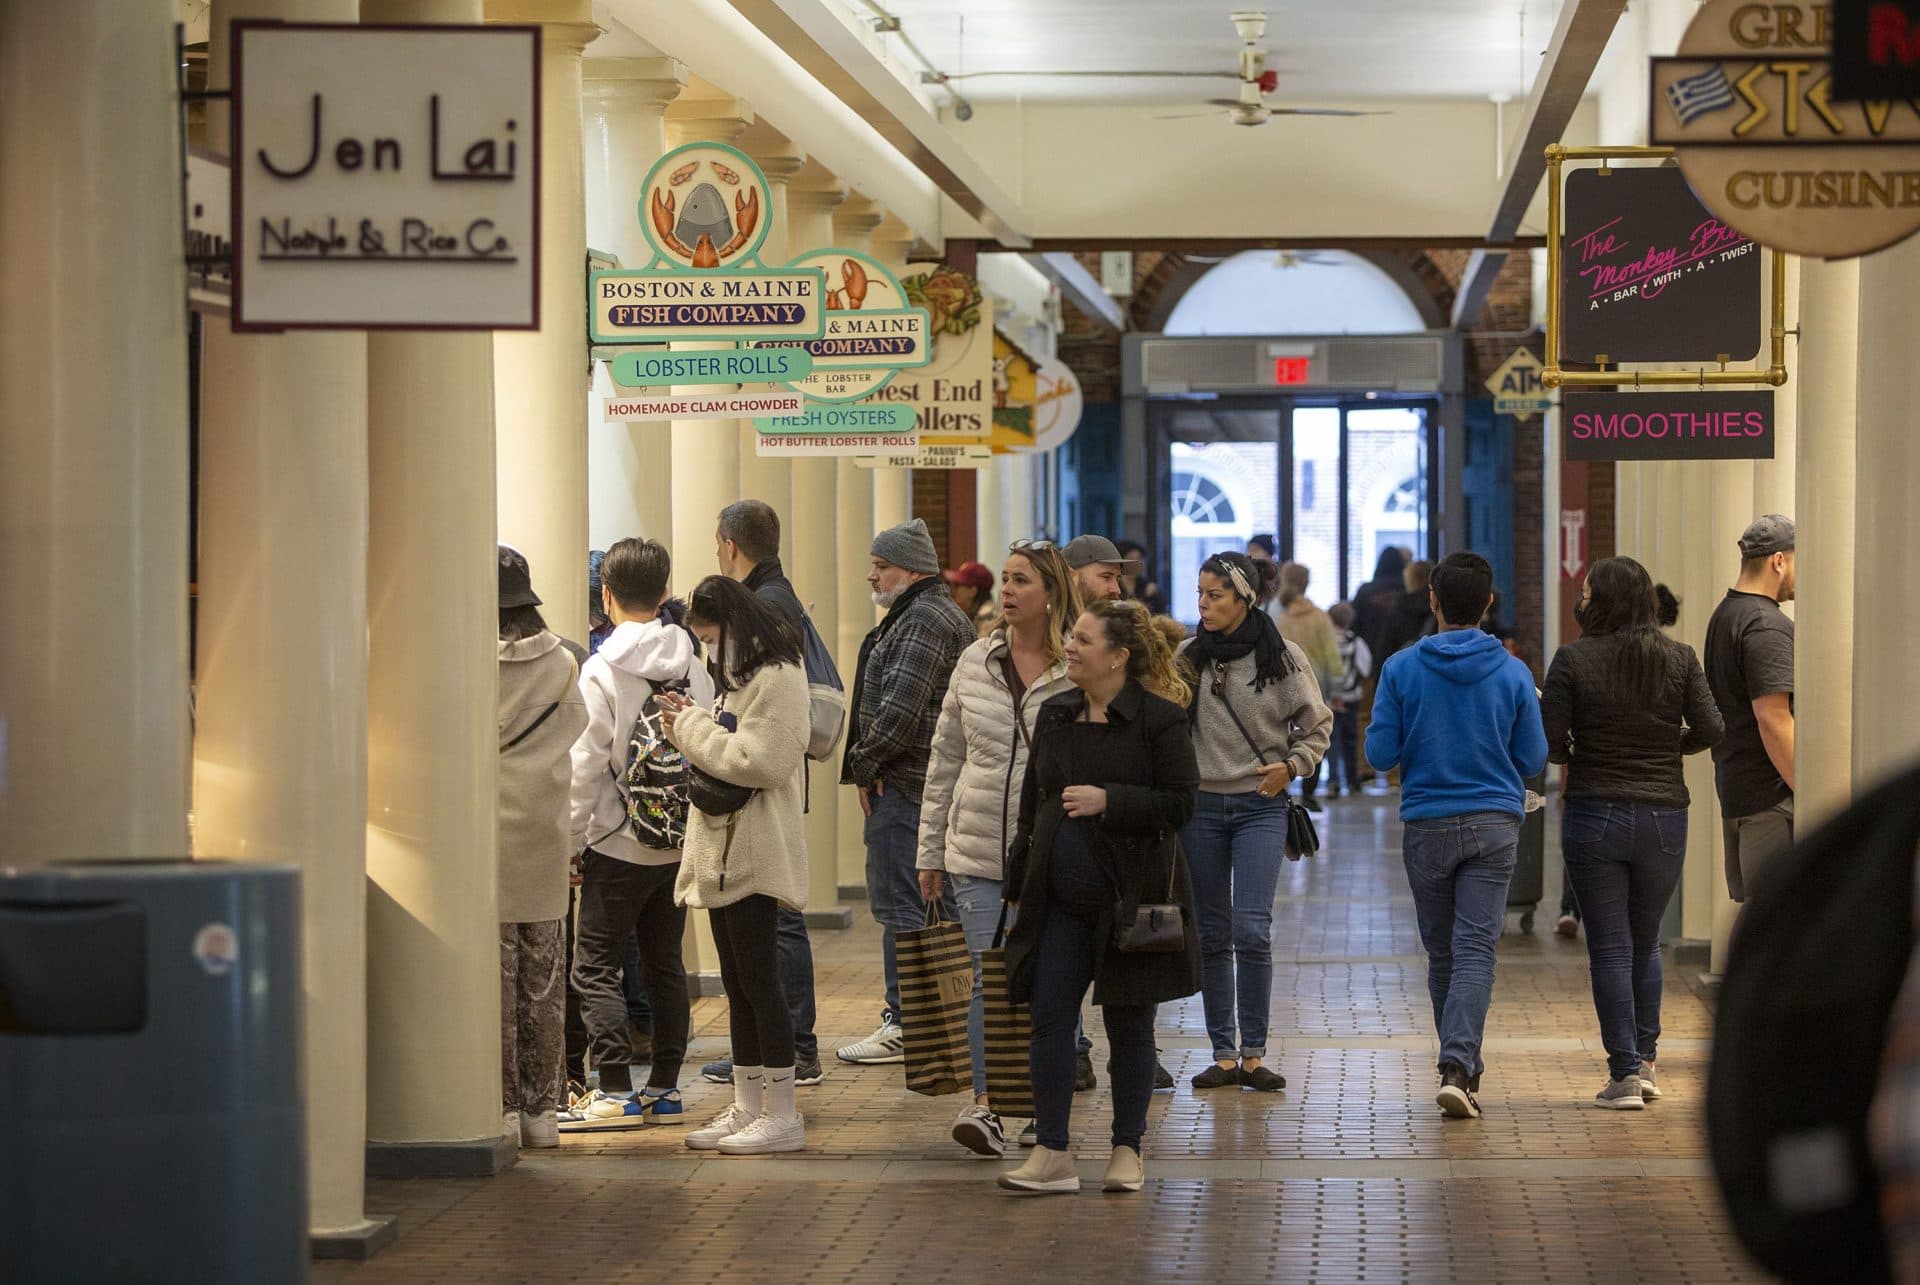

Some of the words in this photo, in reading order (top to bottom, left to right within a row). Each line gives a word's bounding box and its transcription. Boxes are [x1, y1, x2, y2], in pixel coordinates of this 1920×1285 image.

[258, 92, 401, 180] Jen
[431, 92, 516, 181] Lai
[1724, 169, 1920, 210] CUISINE
[359, 217, 388, 254] &
[402, 217, 458, 252] Rice
[1571, 216, 1629, 262] The
[1580, 246, 1688, 294] Monkey
[1590, 300, 1599, 311] A
[1613, 286, 1638, 302] BAR
[1652, 269, 1681, 288] WITH
[1696, 261, 1705, 272] A
[1719, 242, 1755, 263] TWIST
[602, 281, 695, 299] BOSTON
[700, 281, 715, 298] &
[723, 280, 811, 298] MAINE
[615, 305, 671, 324] FISH
[676, 304, 798, 324] COMPANY
[829, 321, 841, 334] &
[847, 319, 919, 333] MAINE
[810, 338, 908, 354] COMPANY
[636, 357, 721, 378] LOBSTER
[727, 355, 788, 375] ROLLS
[801, 374, 819, 383] HE
[826, 374, 871, 383] LOBSTER
[826, 385, 846, 393] BAR
[1501, 366, 1545, 395] ATM
[933, 379, 981, 402] End
[608, 402, 687, 416] HOMEMADE
[690, 401, 727, 413] CLAM
[730, 398, 798, 412] CHOWDER
[772, 411, 821, 426] FRESH
[826, 410, 896, 425] OYSTERS
[1572, 411, 1764, 440] SMOOTHIES
[761, 437, 785, 447] HOT
[786, 437, 827, 447] BUTTER
[830, 437, 877, 446] LOBSTER
[883, 437, 915, 446] ROLLS
[889, 457, 915, 466] PASTA
